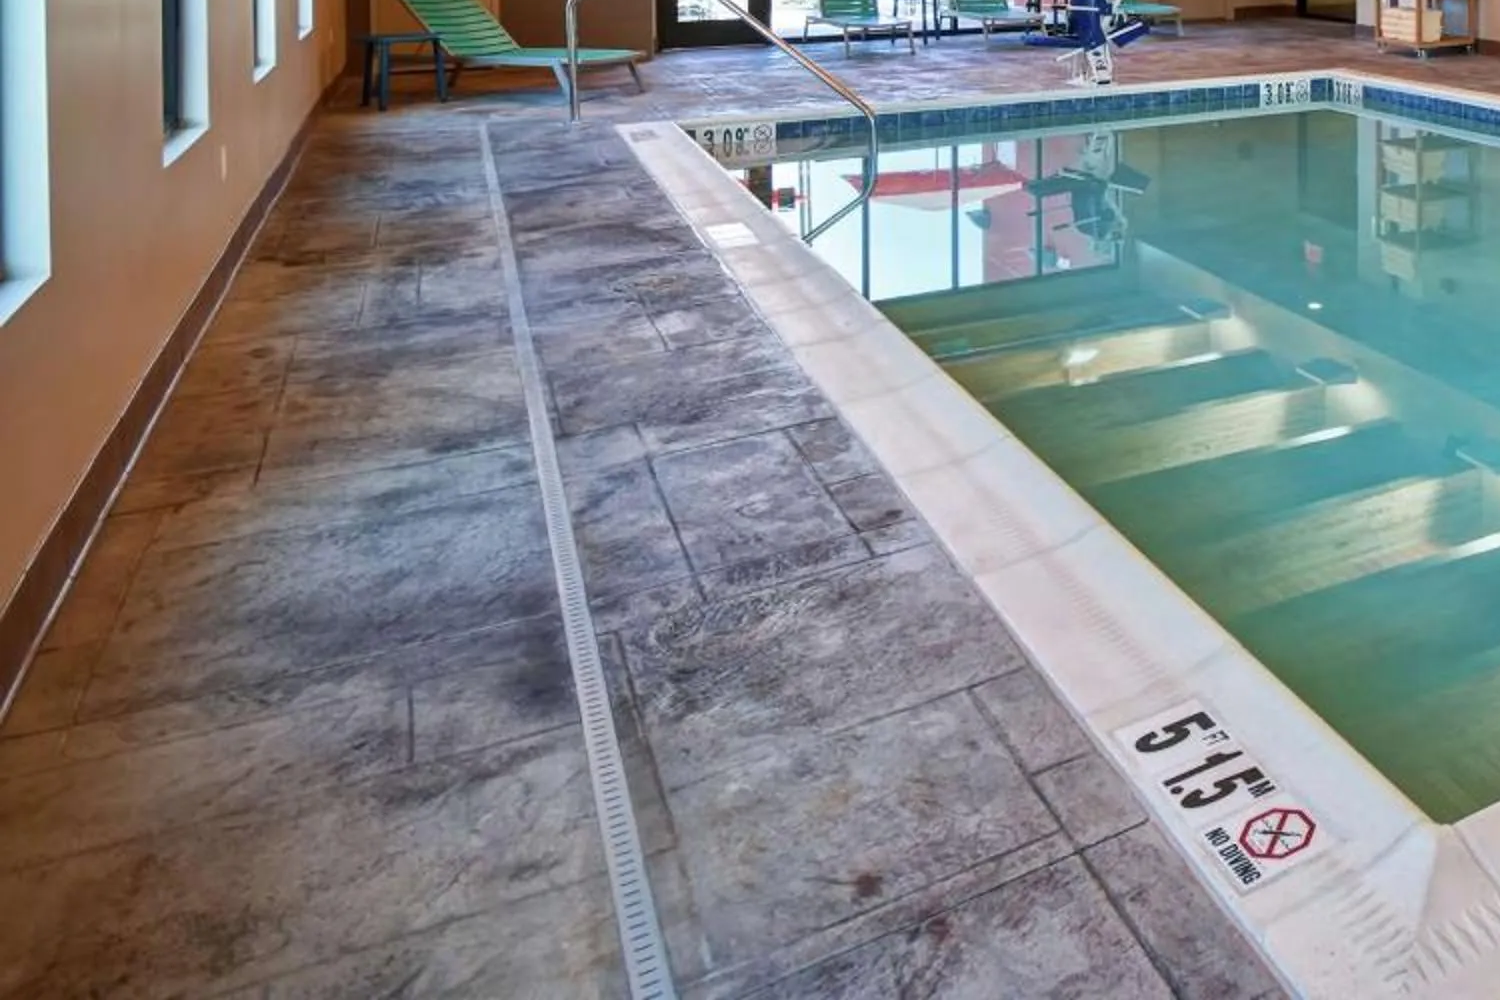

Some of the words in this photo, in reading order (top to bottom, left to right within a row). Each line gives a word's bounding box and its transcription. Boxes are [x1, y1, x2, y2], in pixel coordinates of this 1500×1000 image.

[1135, 711, 1216, 753] 5
[1162, 749, 1265, 809] 1.5
[1248, 780, 1276, 798] M
[1204, 827, 1231, 847] NO
[1218, 843, 1262, 885] DIVING
